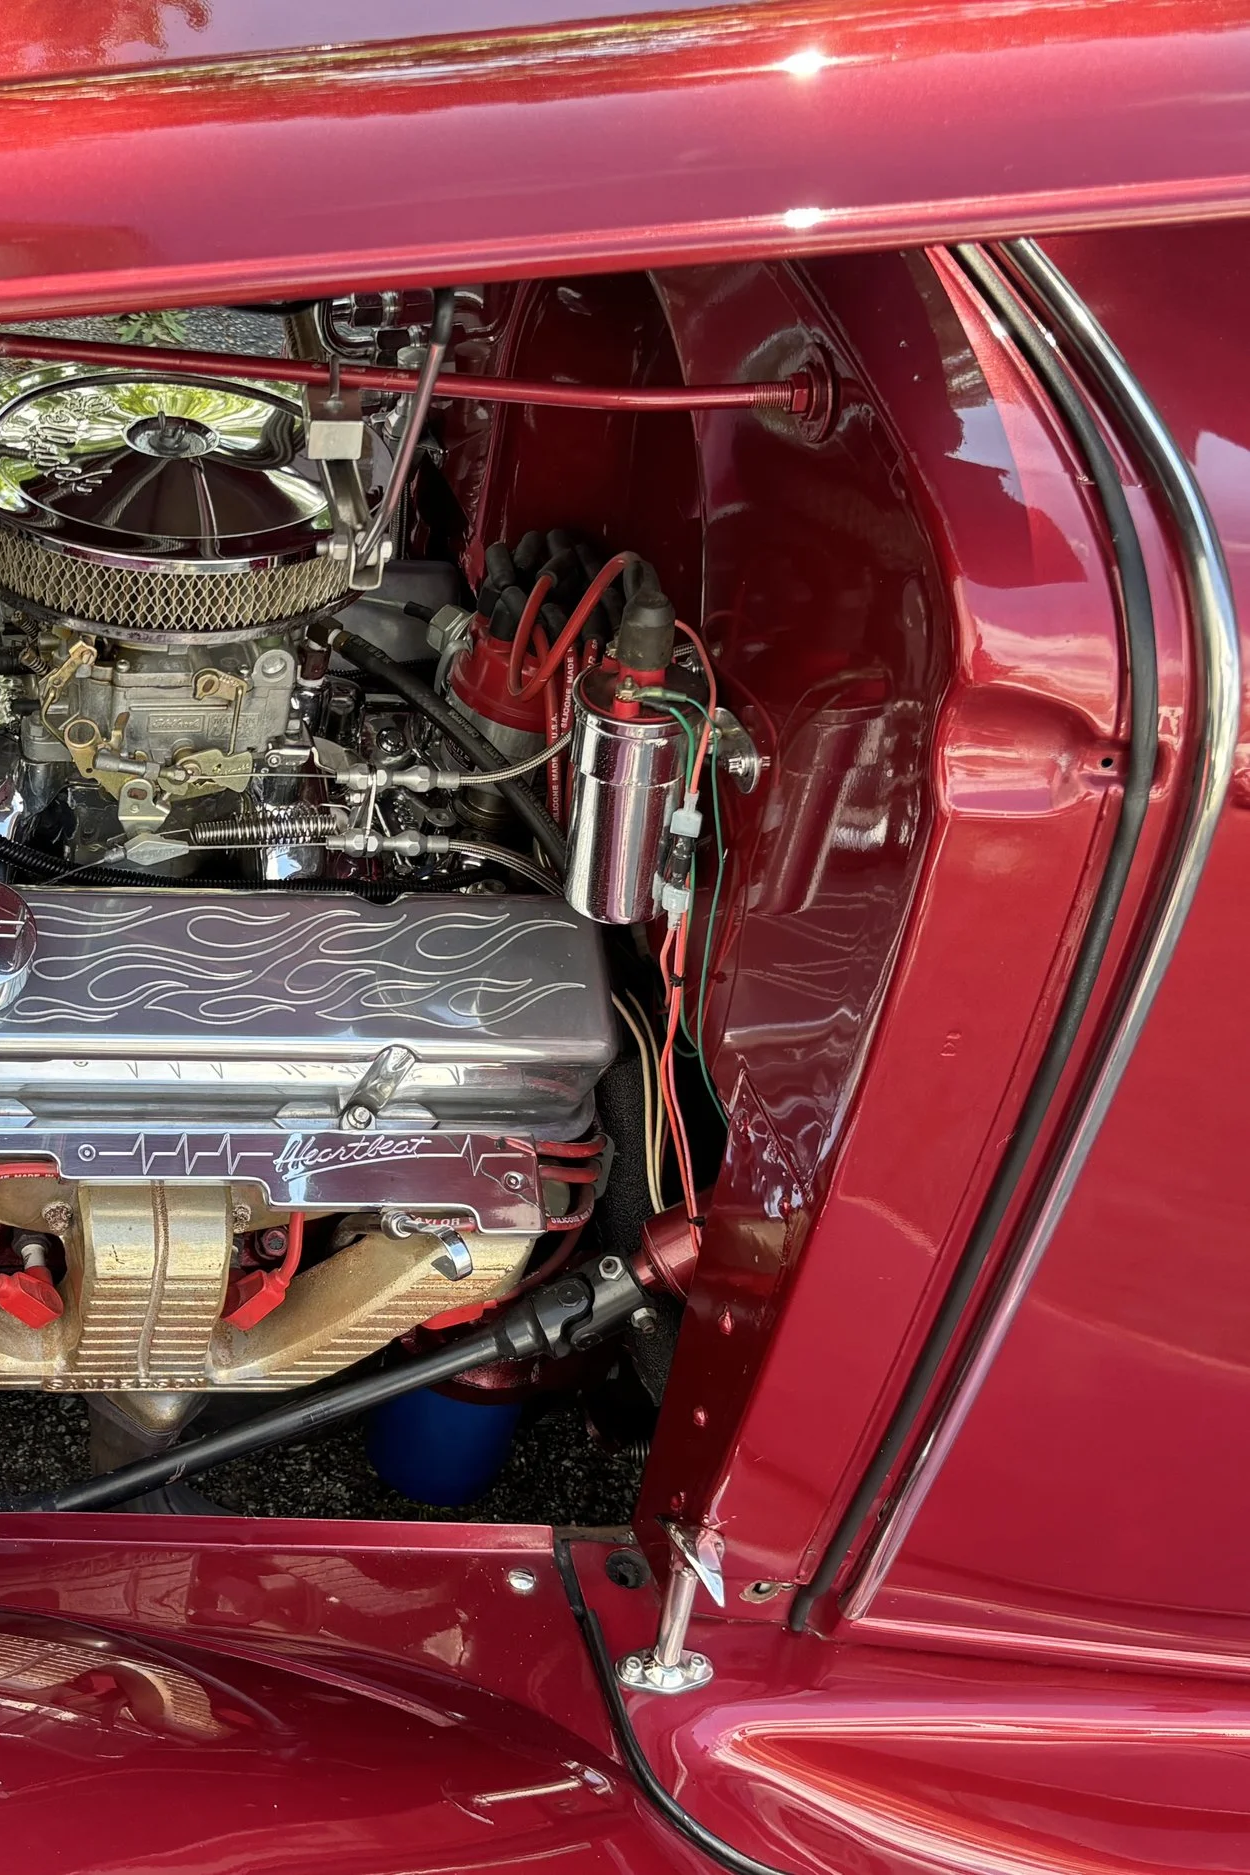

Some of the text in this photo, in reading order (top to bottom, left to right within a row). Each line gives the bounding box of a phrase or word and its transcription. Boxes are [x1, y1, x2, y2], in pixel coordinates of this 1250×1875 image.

[566, 656, 575, 685] MADE
[561, 688, 573, 728] SILICONE
[273, 1135, 432, 1174] Heartbeat
[413, 1215, 461, 1226] AYLOR
[46, 1377, 205, 1391] SANDERSON
